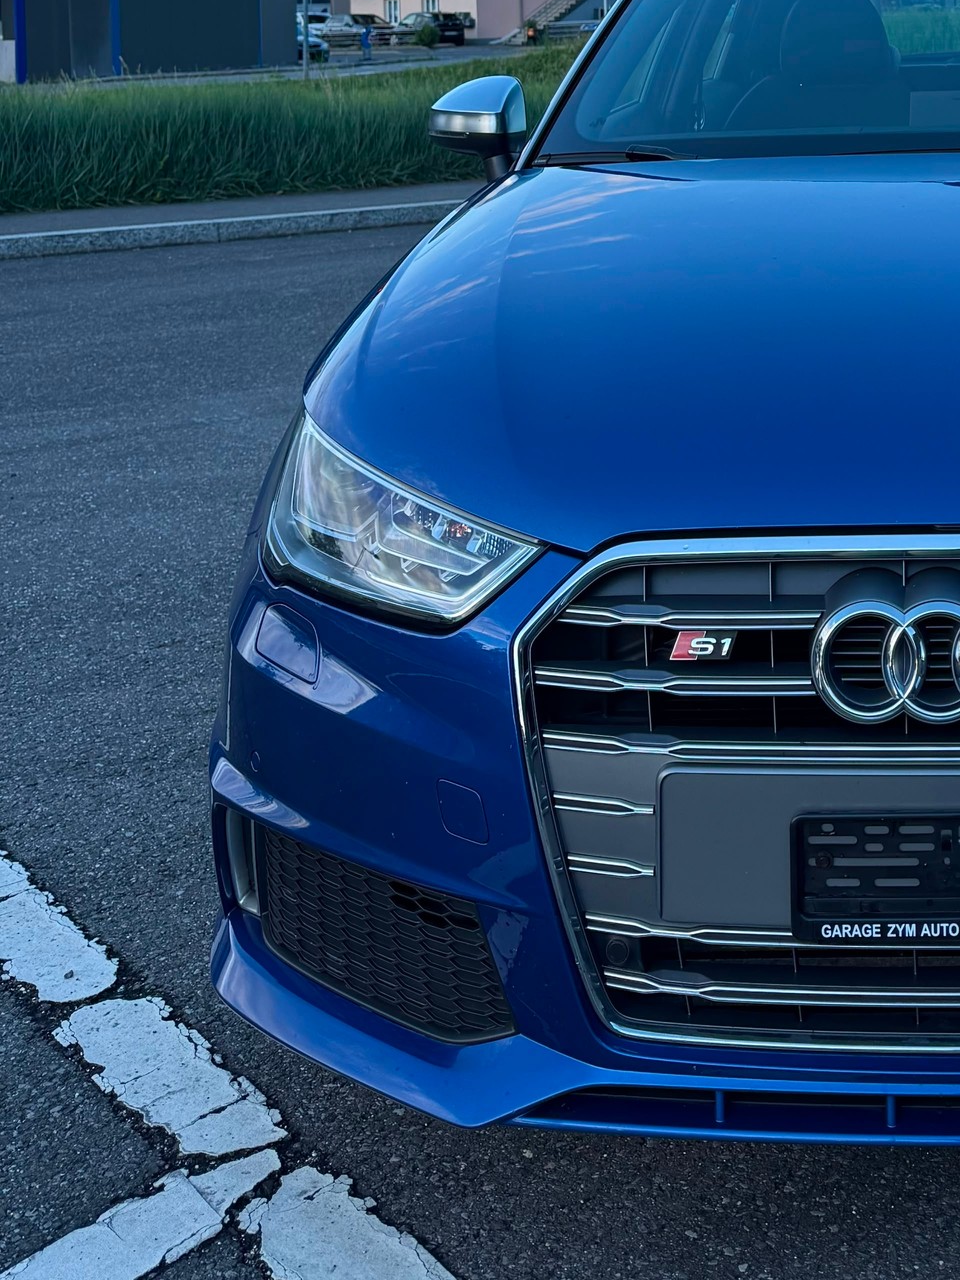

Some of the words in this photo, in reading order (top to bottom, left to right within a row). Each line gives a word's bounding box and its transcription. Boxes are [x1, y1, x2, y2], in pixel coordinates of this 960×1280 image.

[687, 637, 732, 656] S1
[821, 923, 881, 938] GARAGE
[887, 923, 917, 937] ZYM
[920, 923, 960, 937] AUTO
